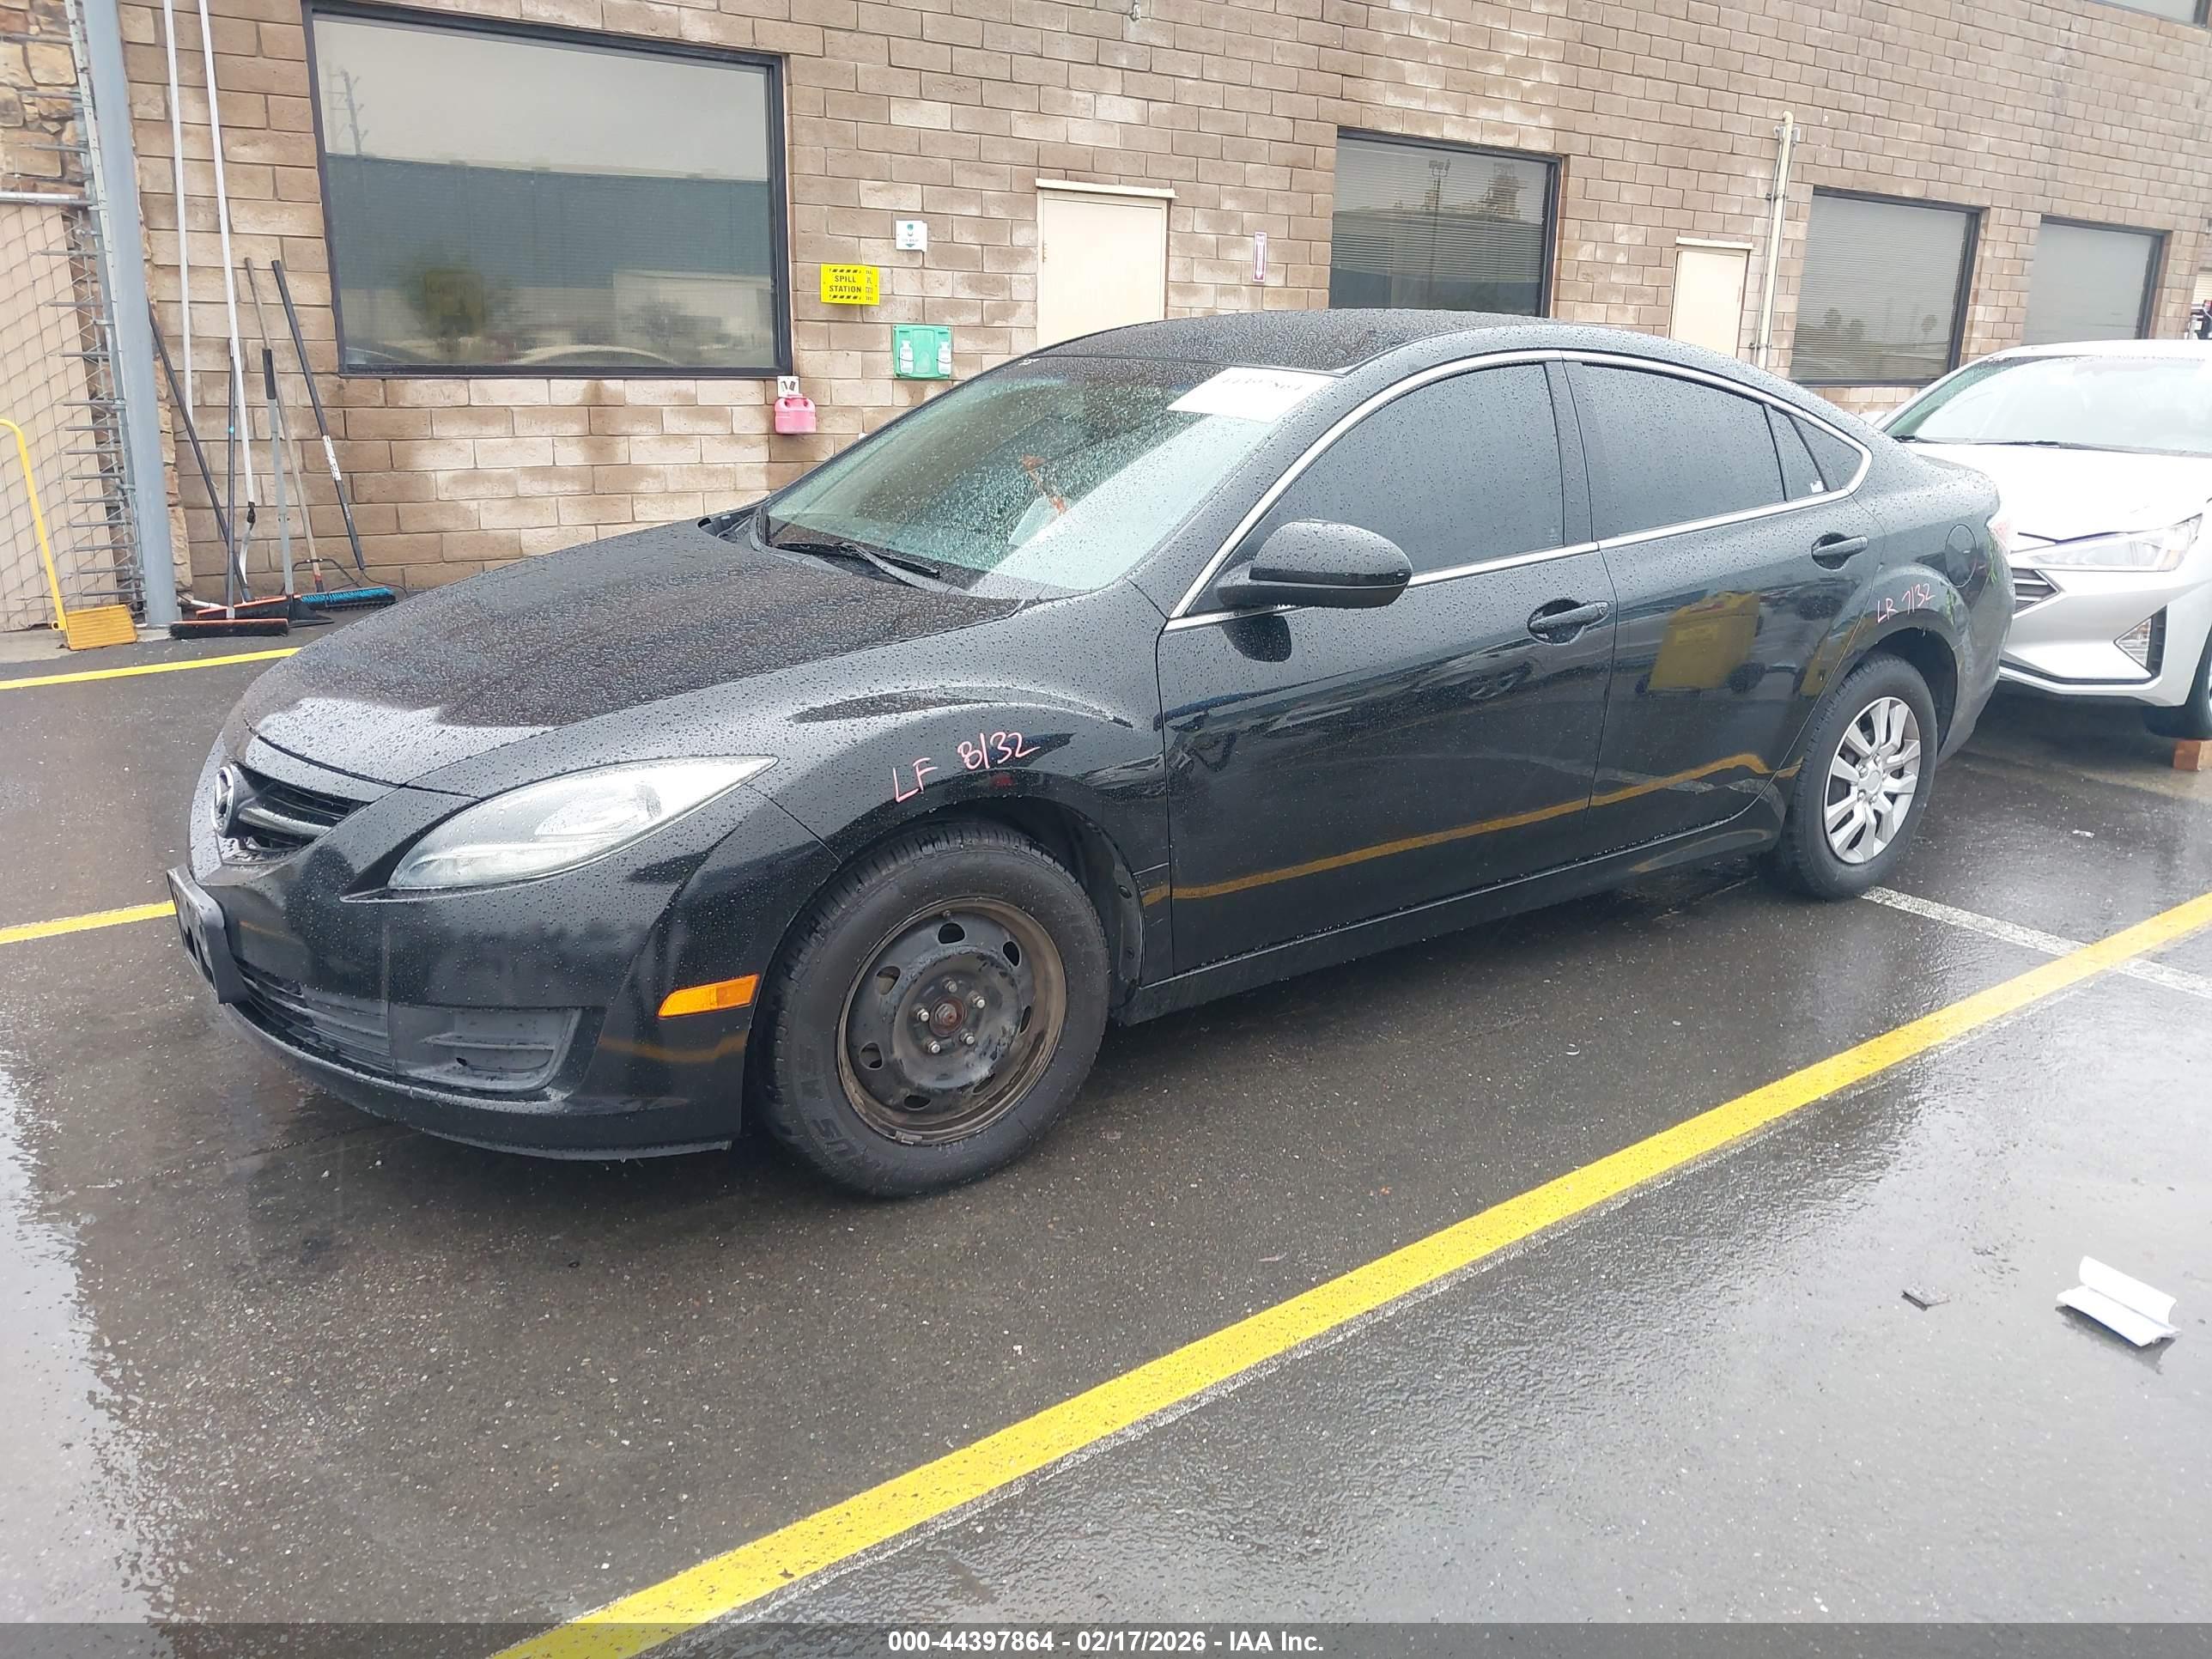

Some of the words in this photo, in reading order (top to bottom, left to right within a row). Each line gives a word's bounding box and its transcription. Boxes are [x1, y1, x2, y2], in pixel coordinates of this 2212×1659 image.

[834, 275, 857, 283] SPILL
[829, 284, 862, 294] STATION
[1877, 597, 1899, 624] LR
[892, 757, 939, 804] LF
